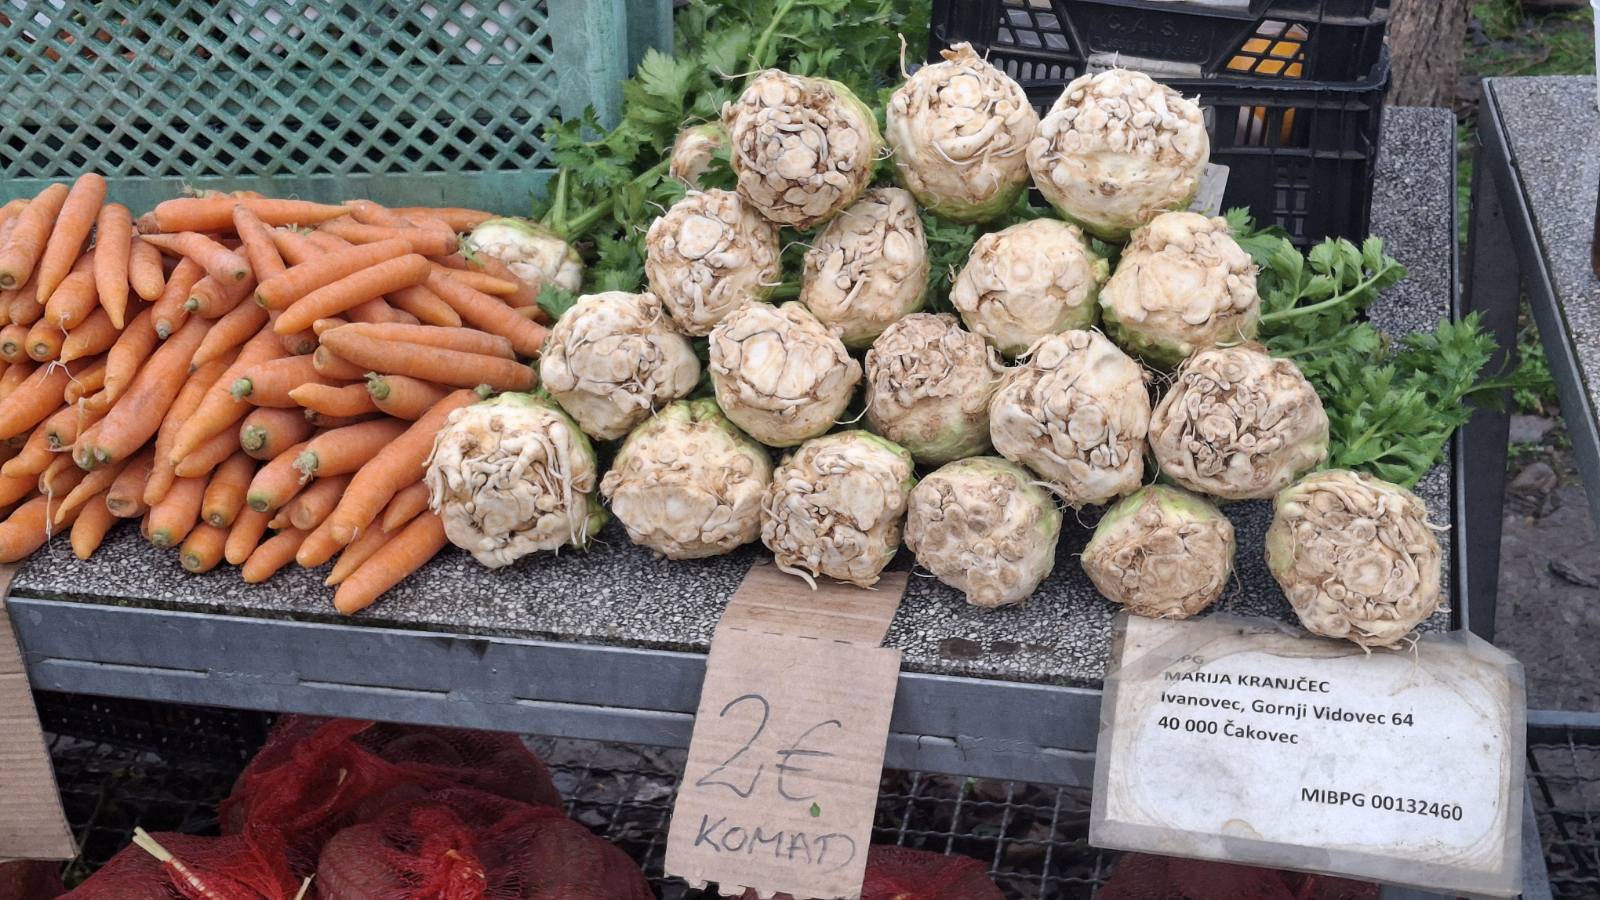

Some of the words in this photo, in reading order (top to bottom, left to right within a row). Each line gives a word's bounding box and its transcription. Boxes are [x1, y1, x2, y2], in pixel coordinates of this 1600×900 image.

[1164, 671, 1232, 685] MARIJA
[1238, 675, 1330, 693] KRANJČEC
[1161, 692, 1245, 713] Ivanovec,
[1251, 700, 1307, 720] Gornji
[1313, 705, 1386, 725] Vidovec
[1391, 713, 1414, 727] 64
[1158, 716, 1180, 730] 40
[1185, 719, 1218, 735] 000
[1223, 720, 1299, 744] Čakovec
[1301, 788, 1366, 807] MIBPG
[1371, 795, 1463, 821] 00132460
[694, 814, 856, 874] KOMAD
